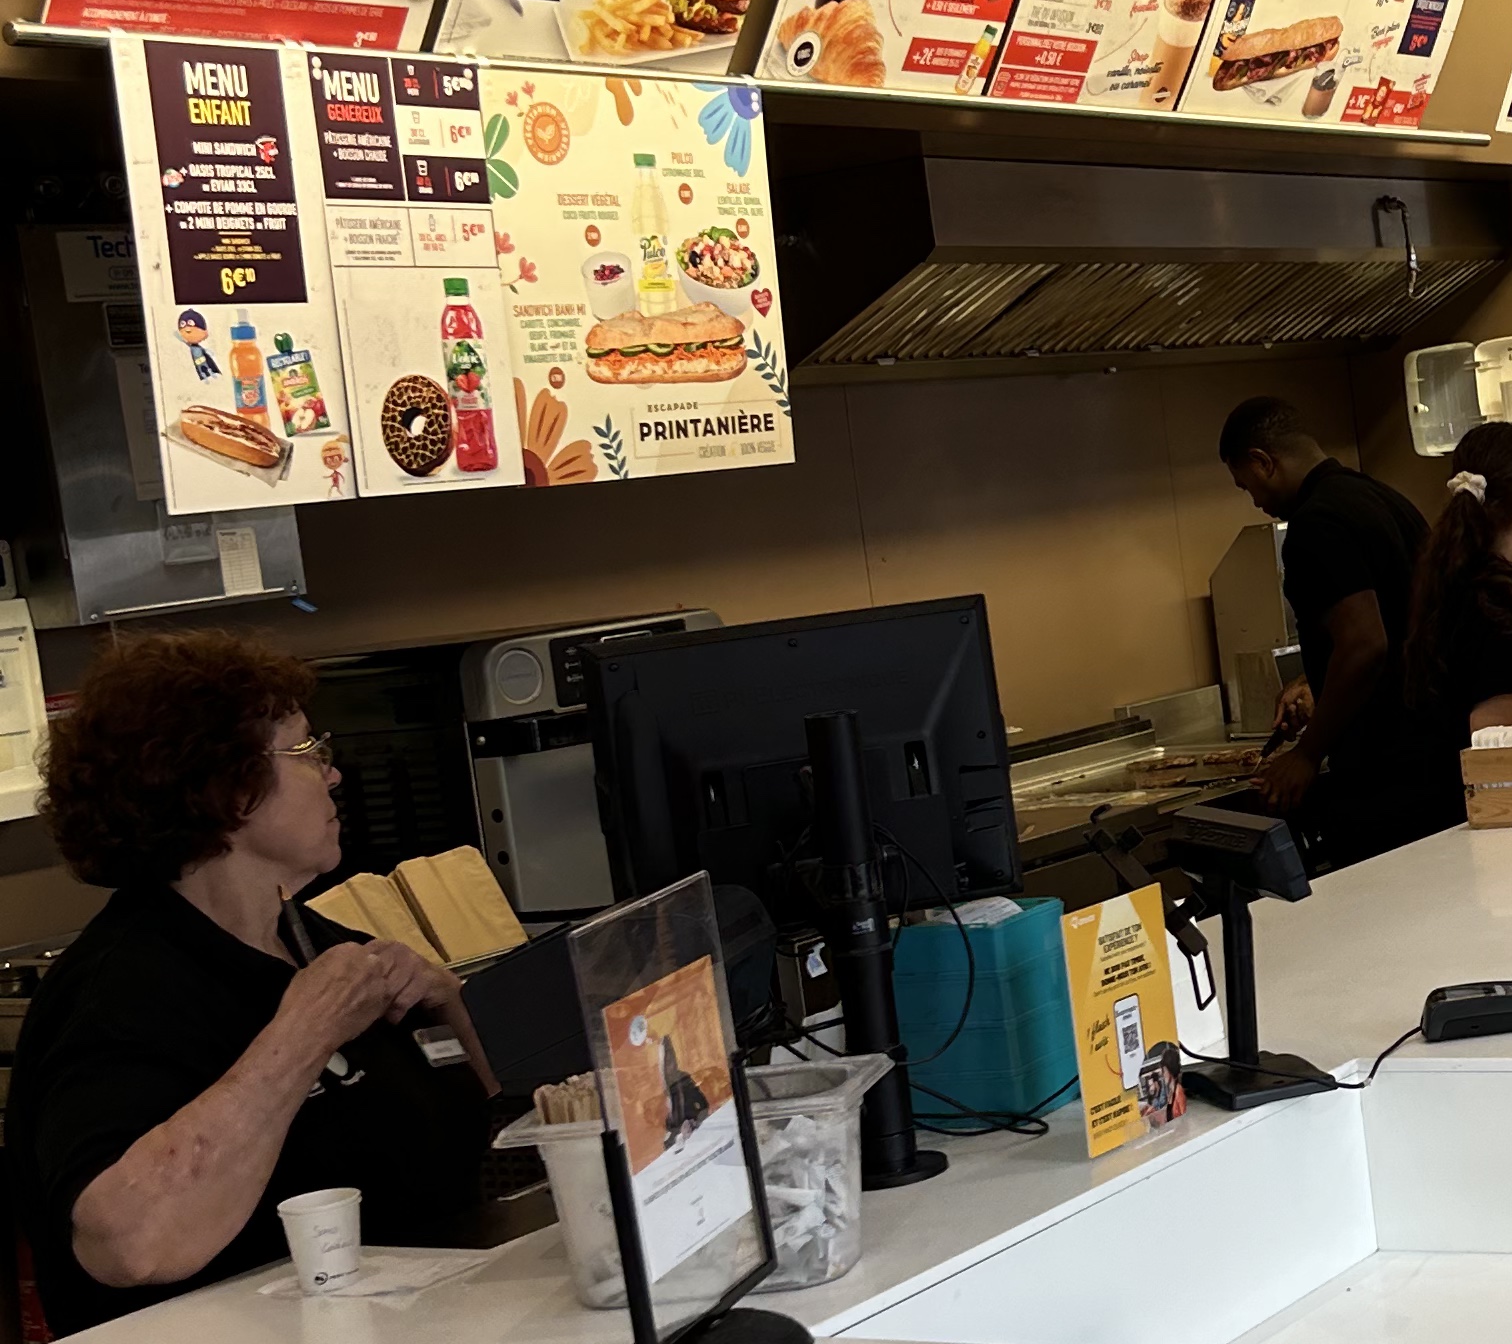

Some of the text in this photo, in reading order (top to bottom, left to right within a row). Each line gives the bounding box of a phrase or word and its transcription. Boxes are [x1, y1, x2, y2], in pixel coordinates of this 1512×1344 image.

[183, 60, 249, 98] MENU
[322, 69, 381, 104] MENU
[187, 97, 252, 126] ENFANT
[188, 163, 215, 178] OASIS
[215, 164, 255, 179] TROPICAL
[174, 200, 212, 215] COMPOTE
[647, 401, 699, 413] ESCAPADE
[638, 408, 776, 442] PRINTANIÈRE
